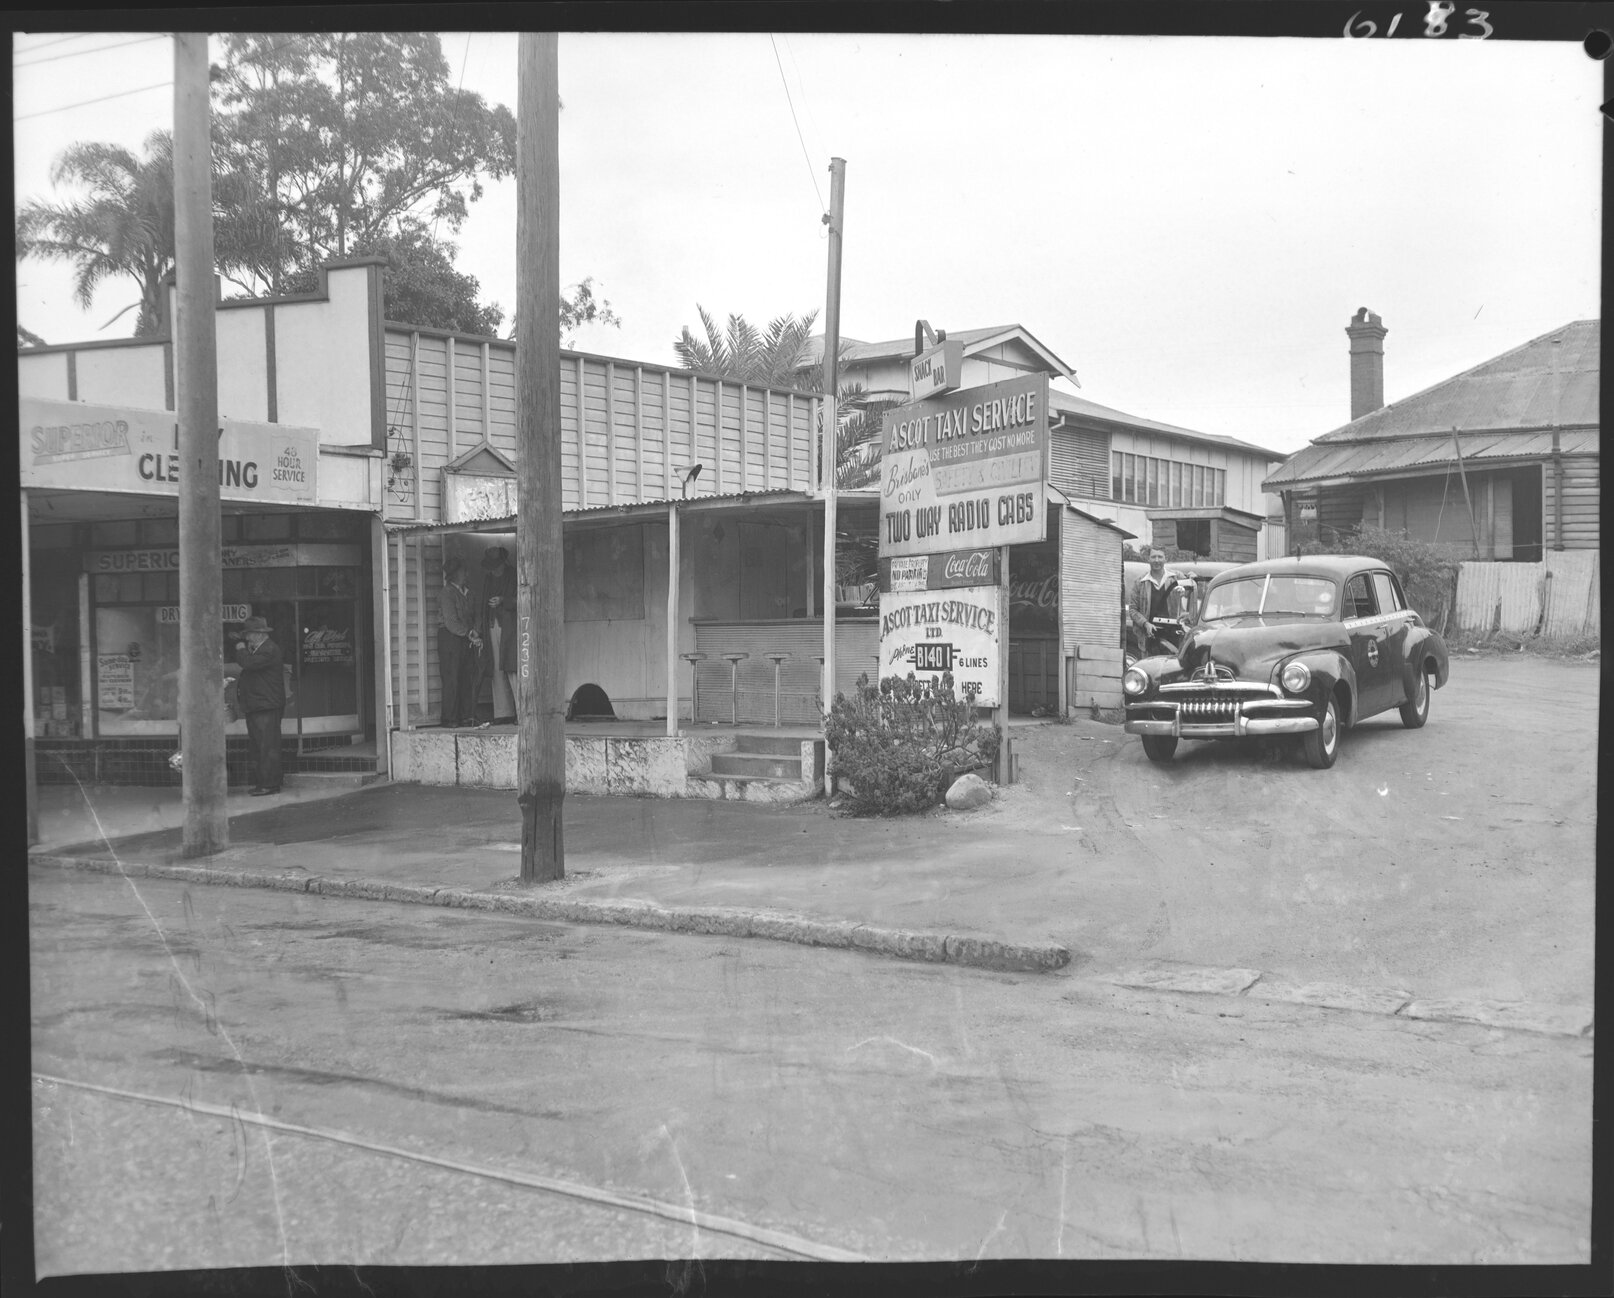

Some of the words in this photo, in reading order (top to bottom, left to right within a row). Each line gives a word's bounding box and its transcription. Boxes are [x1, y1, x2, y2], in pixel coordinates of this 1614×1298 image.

[914, 357, 932, 382] SNACK
[933, 365, 945, 387] BAR
[889, 416, 931, 454] ASCOT
[935, 407, 969, 442] TAXI
[971, 391, 1037, 436] SERVICE
[31, 420, 128, 454] SUPERIOR
[930, 450, 941, 461] USE
[942, 446, 954, 459] THE
[954, 442, 969, 457] BEST
[970, 439, 988, 454] THEY
[989, 435, 1007, 451] COST
[1008, 432, 1018, 446] NO
[1018, 429, 1035, 445] MORE
[139, 454, 258, 488] CLEING
[273, 469, 305, 482] SERVICE
[278, 456, 301, 469] HOUR
[883, 456, 929, 497] Brisbane's
[885, 509, 910, 543] TWO
[915, 505, 940, 538] WAY
[948, 498, 988, 533] RADIO
[997, 493, 1033, 526] CABS
[98, 552, 179, 570] SUPERIO
[945, 552, 989, 579] Coca-Cola
[892, 570, 900, 580] NO
[881, 606, 911, 638] ASCOT
[912, 602, 939, 624] TAXI
[940, 600, 995, 636] SERVICE
[521, 616, 530, 678] 7236
[959, 658, 964, 668] 6
[965, 657, 988, 668] LINES
[961, 681, 982, 695] HERE
